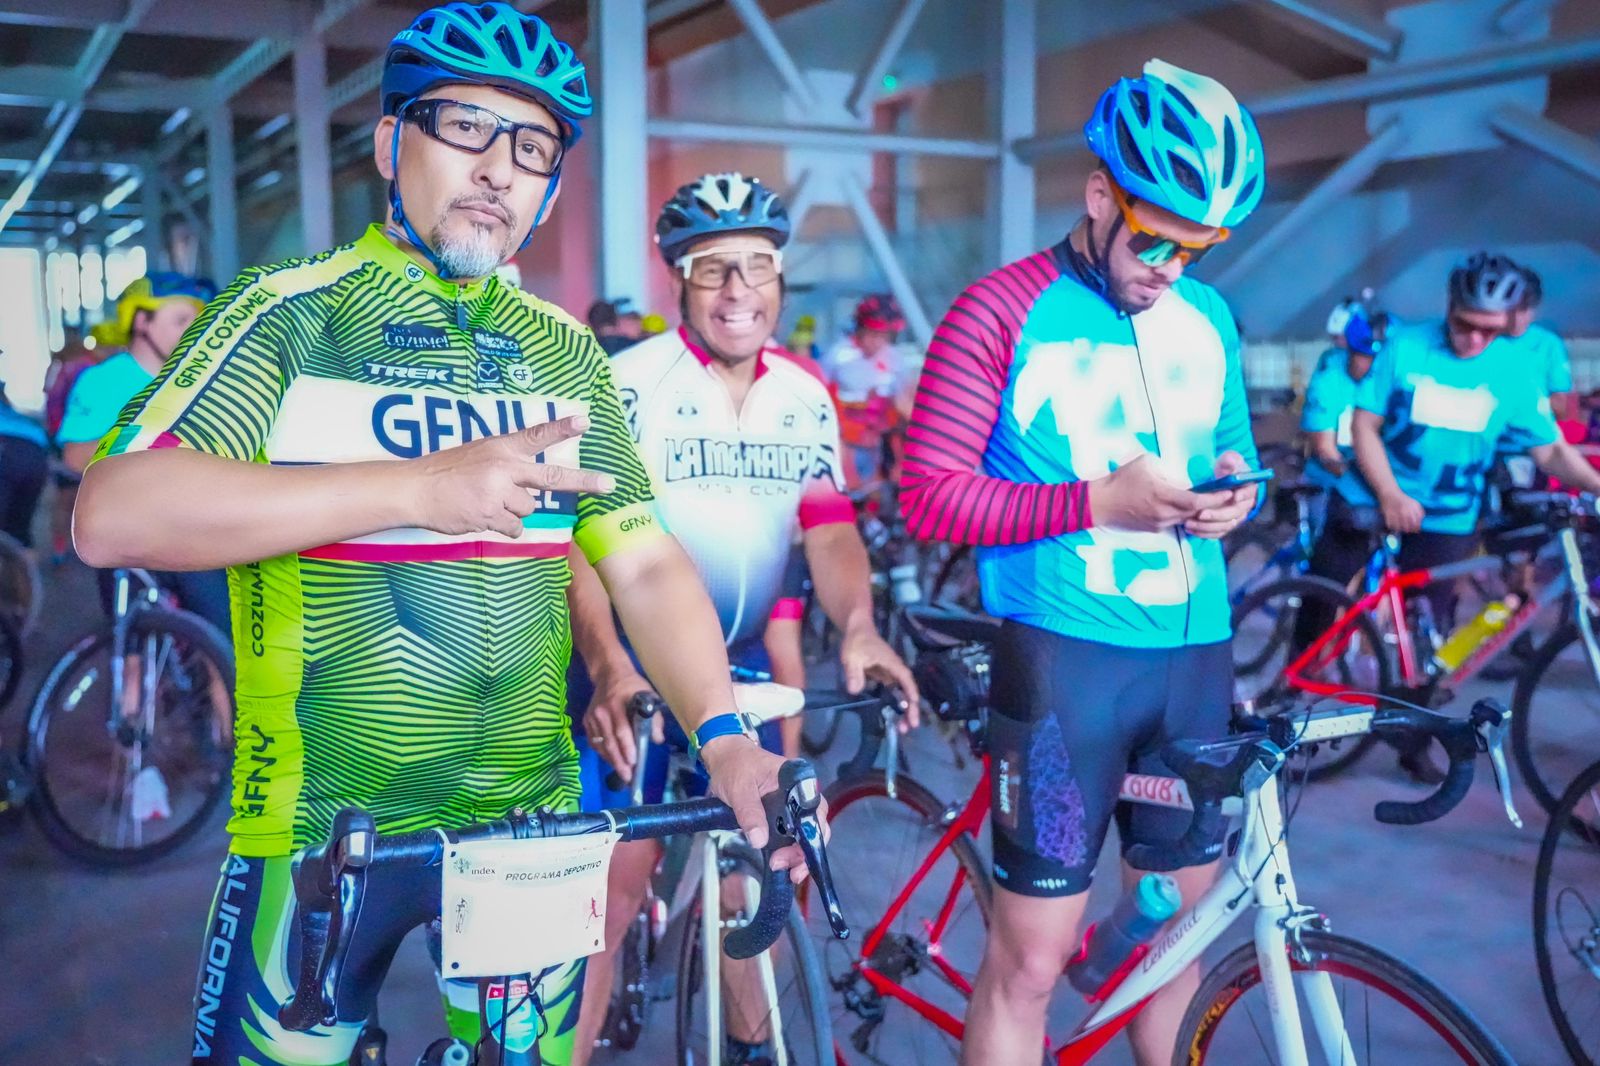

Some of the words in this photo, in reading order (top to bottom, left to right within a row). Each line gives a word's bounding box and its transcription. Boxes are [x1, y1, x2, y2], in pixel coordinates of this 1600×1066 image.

[175, 350, 213, 388] GFNY
[206, 288, 277, 350] COZUMEL
[366, 363, 451, 381] TREK
[619, 514, 652, 533] GFNY
[471, 867, 496, 875] index
[505, 870, 561, 881] PROGRAMA
[563, 860, 602, 877] DEPORTIVO
